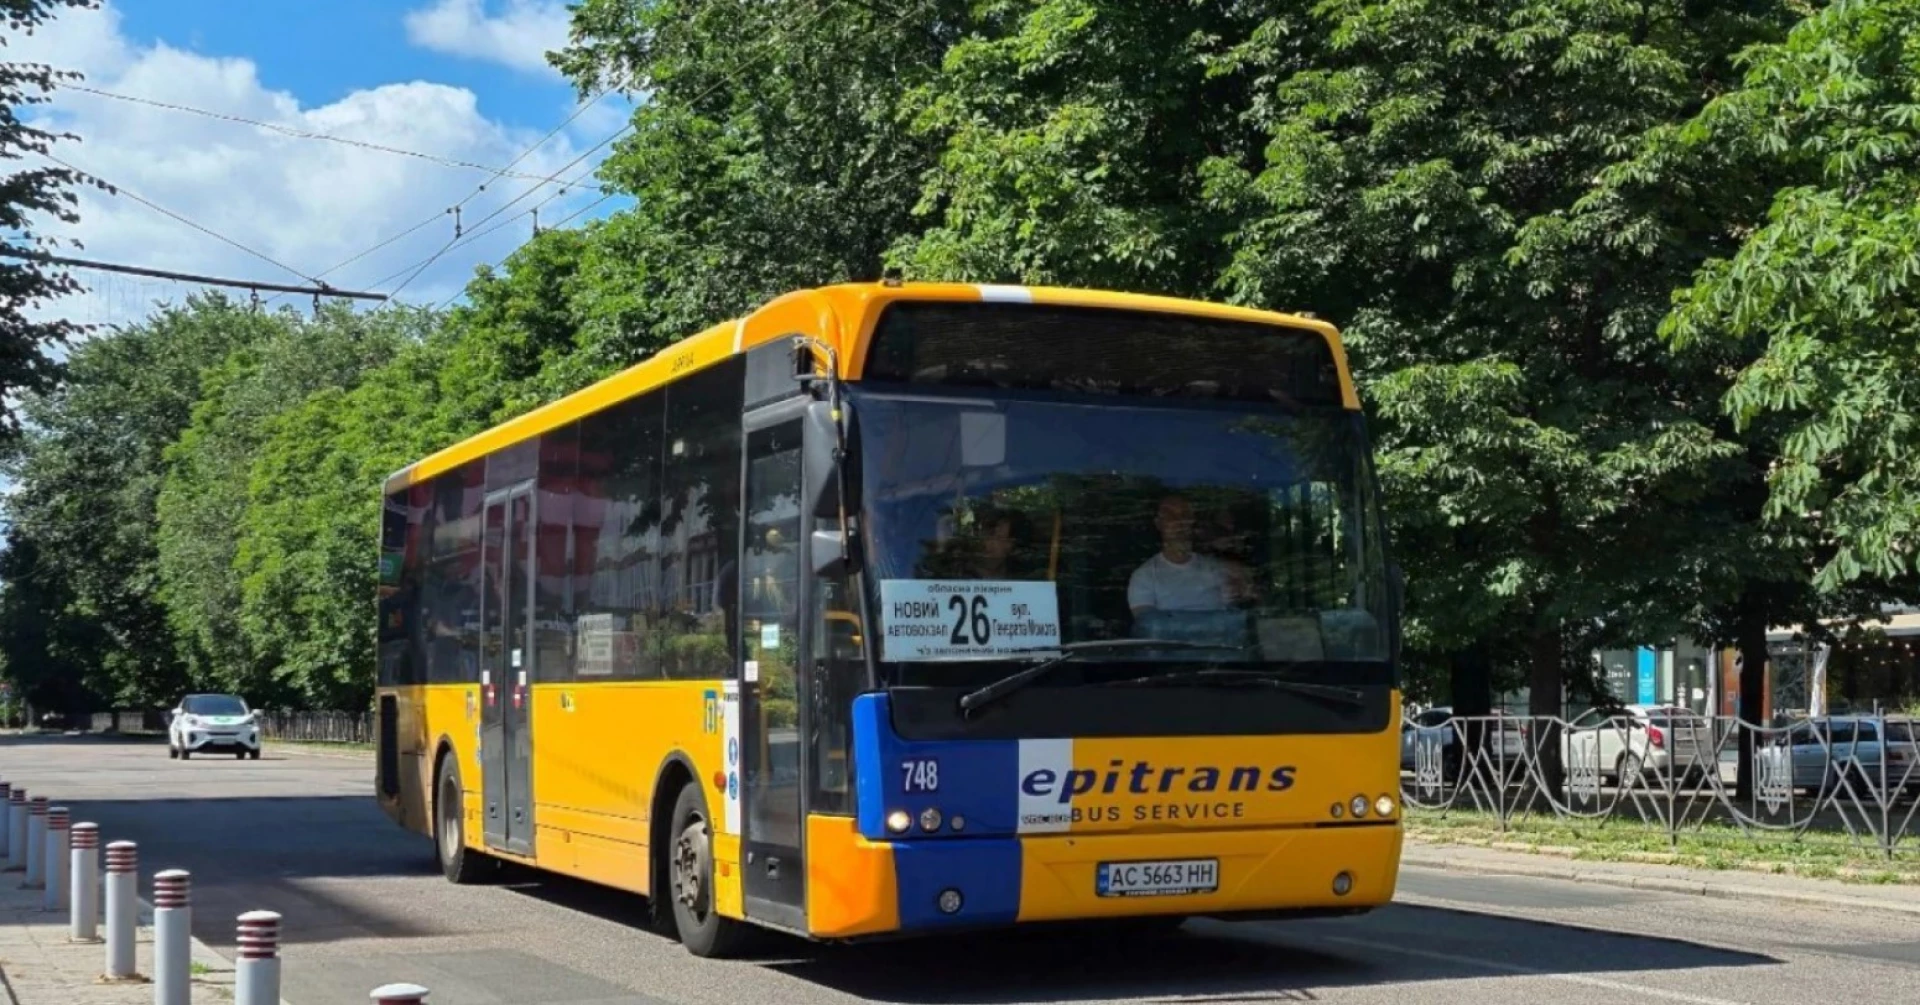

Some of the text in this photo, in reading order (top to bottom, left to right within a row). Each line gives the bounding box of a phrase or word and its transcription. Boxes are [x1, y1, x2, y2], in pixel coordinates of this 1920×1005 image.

[894, 598, 939, 618] НОВИЙ
[888, 624, 948, 637] АВТОВОКЗАЛ
[948, 594, 990, 645] 26
[902, 761, 938, 791] 748
[1021, 758, 1297, 803] epitrans
[1072, 802, 1245, 822] BUS SERVICE
[1111, 867, 1137, 886] AC
[1143, 865, 1183, 885] 5663
[1187, 864, 1213, 883] HH
